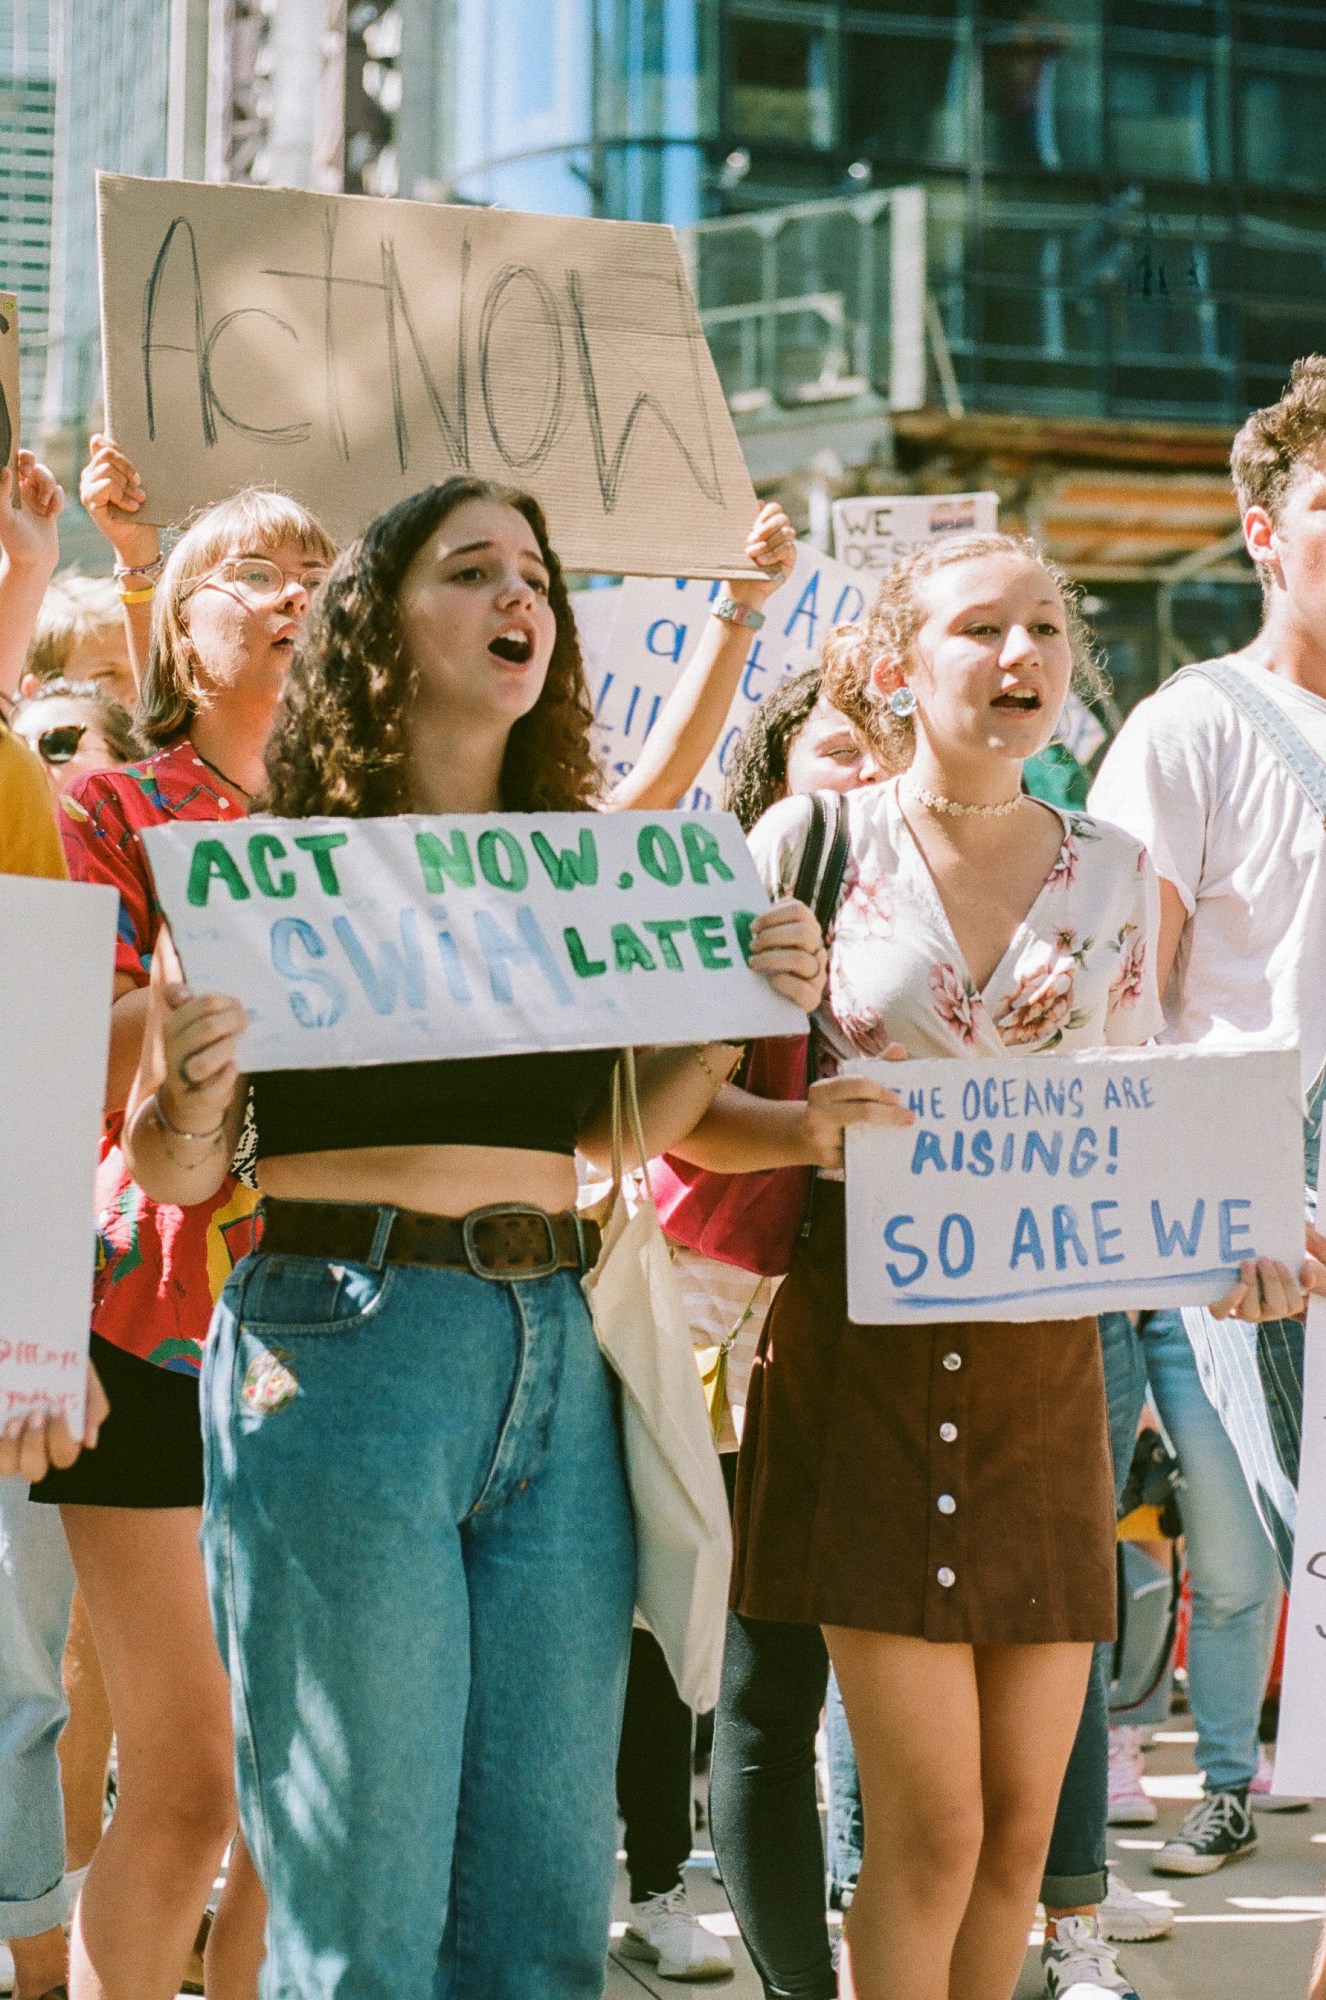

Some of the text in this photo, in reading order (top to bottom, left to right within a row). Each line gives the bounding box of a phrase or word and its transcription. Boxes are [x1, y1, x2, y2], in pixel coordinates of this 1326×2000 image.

[378, 228, 726, 514] NOW
[839, 508, 893, 536] WE
[186, 832, 349, 907] ACT
[891, 1075, 1156, 1122] HE OCEANS ARE
[910, 1125, 1119, 1178] RISING!
[883, 1197, 1257, 1288] SO ARE WE
